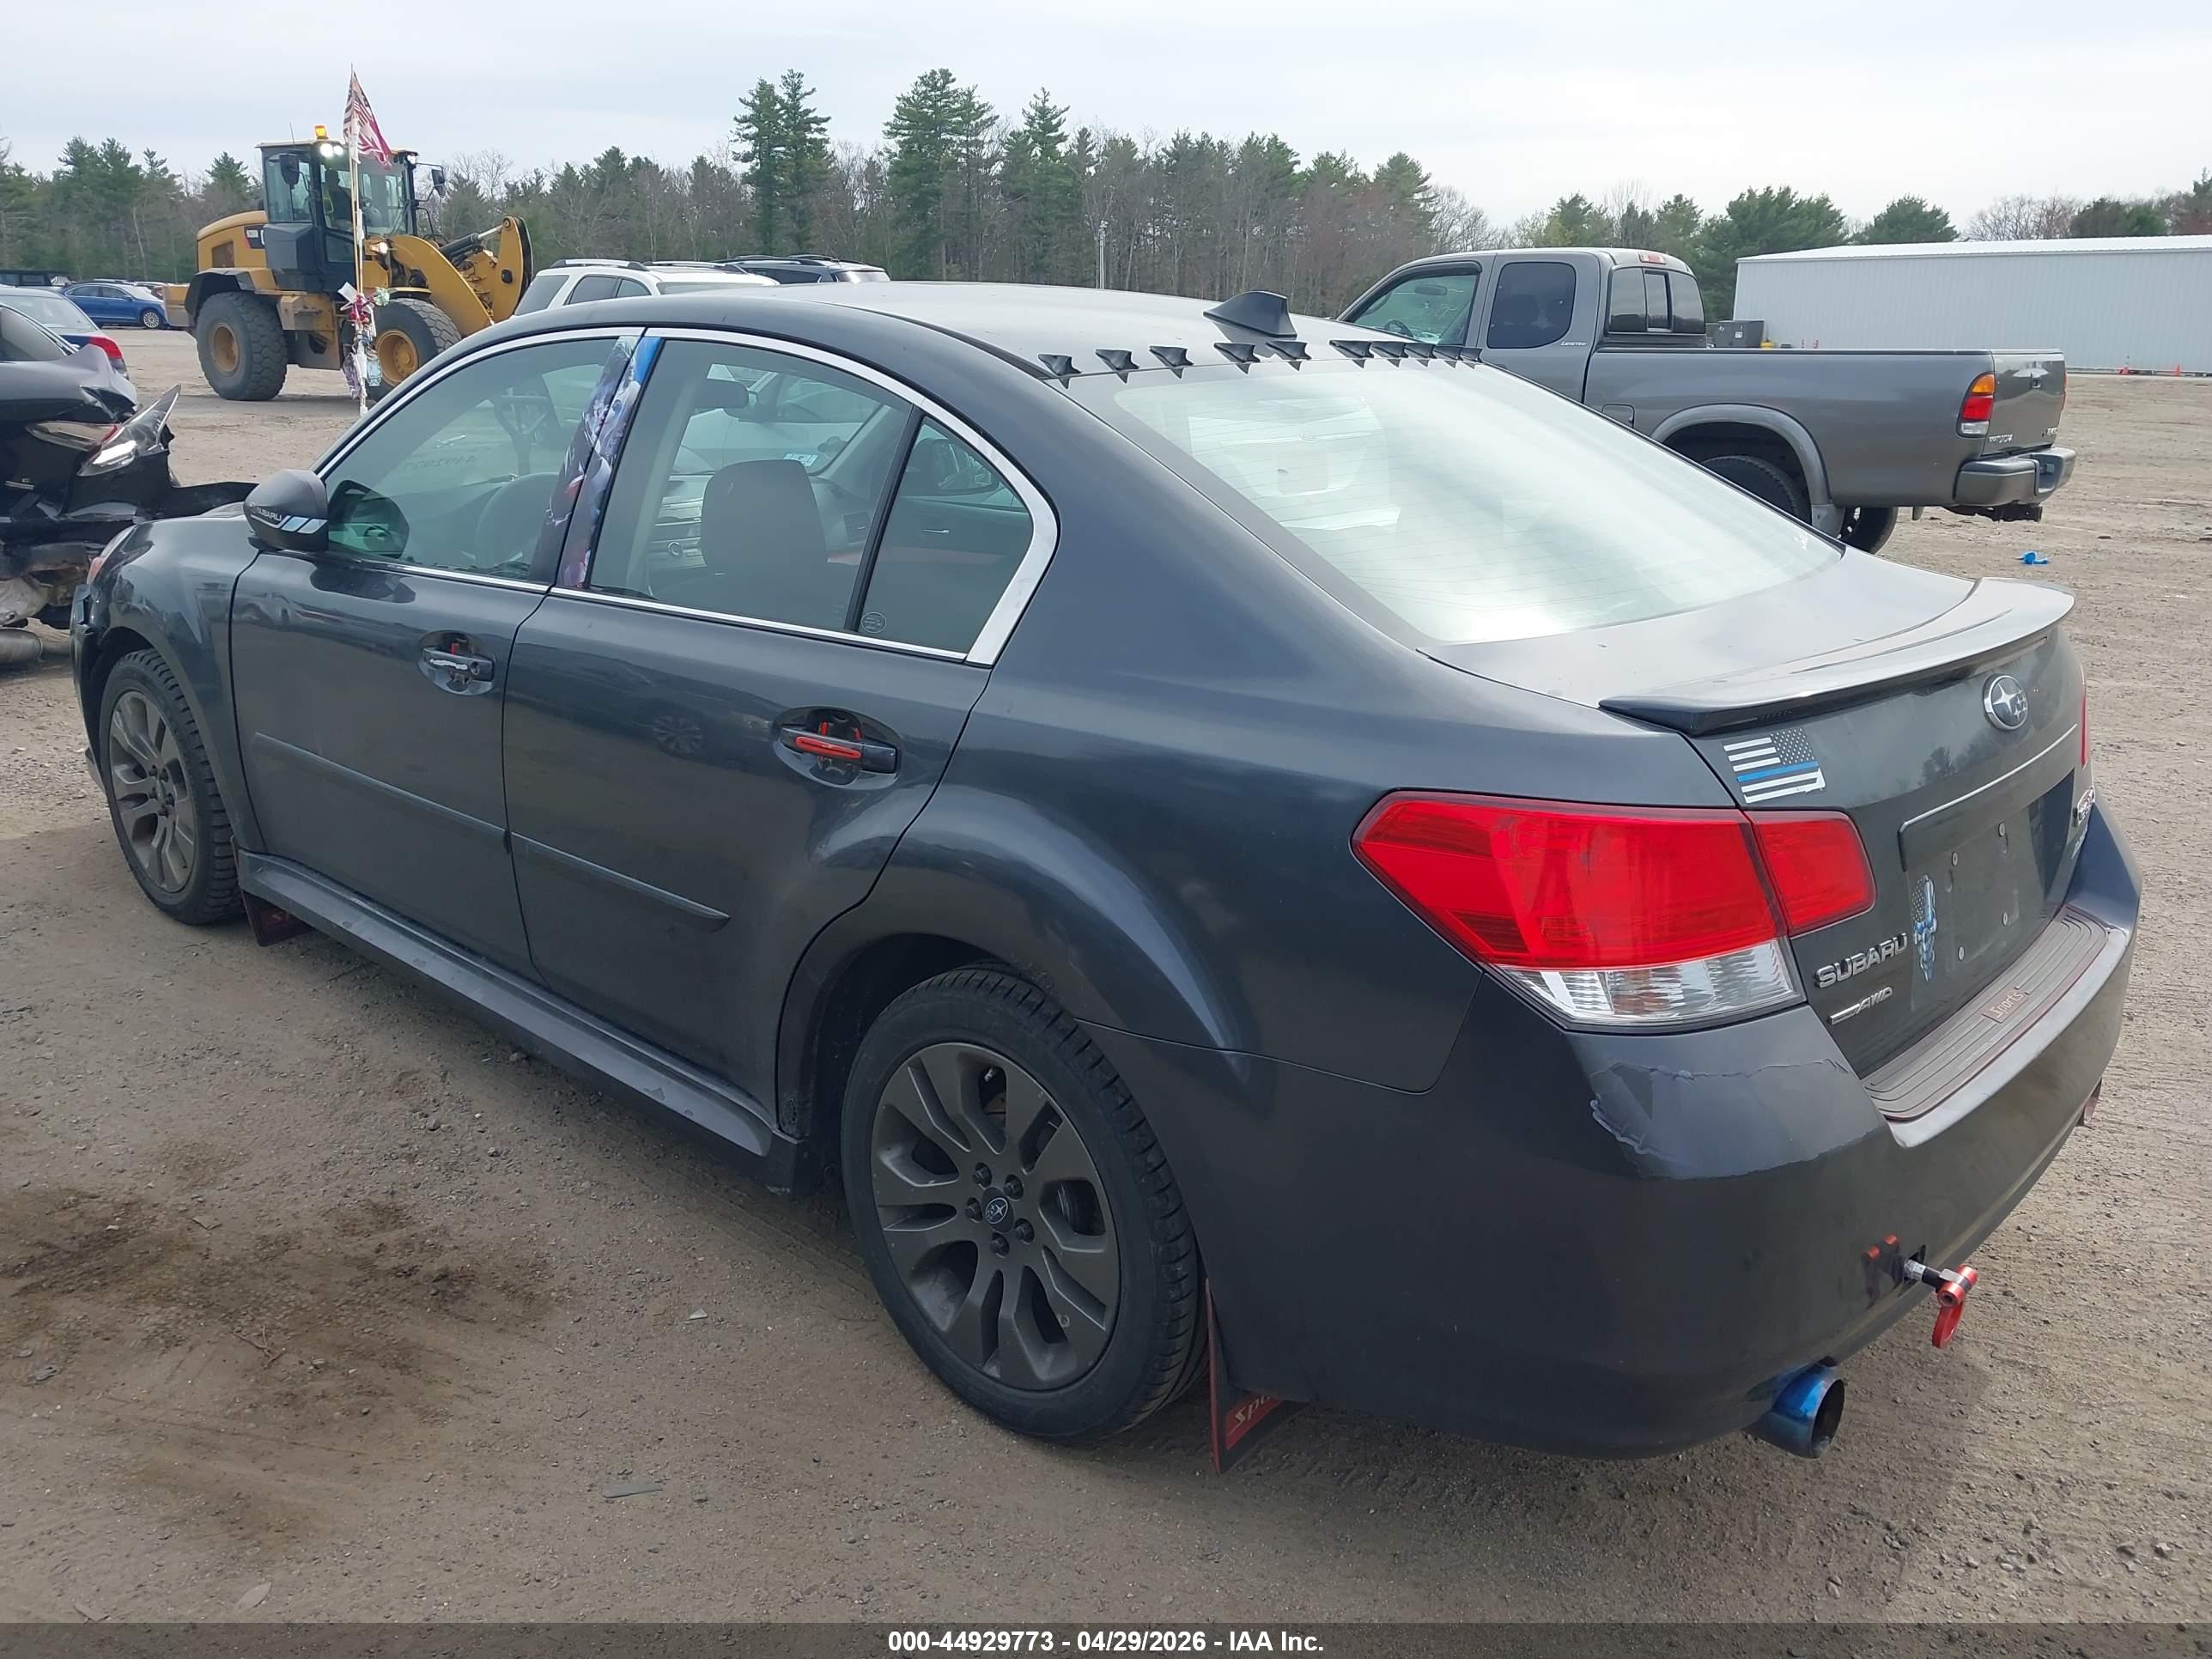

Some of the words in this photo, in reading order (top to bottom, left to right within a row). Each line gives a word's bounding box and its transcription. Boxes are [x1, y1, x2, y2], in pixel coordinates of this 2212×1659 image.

[1815, 932, 1908, 988] SUBARU
[1856, 986, 1893, 1015] AWD
[1989, 991, 2025, 1019] Sports
